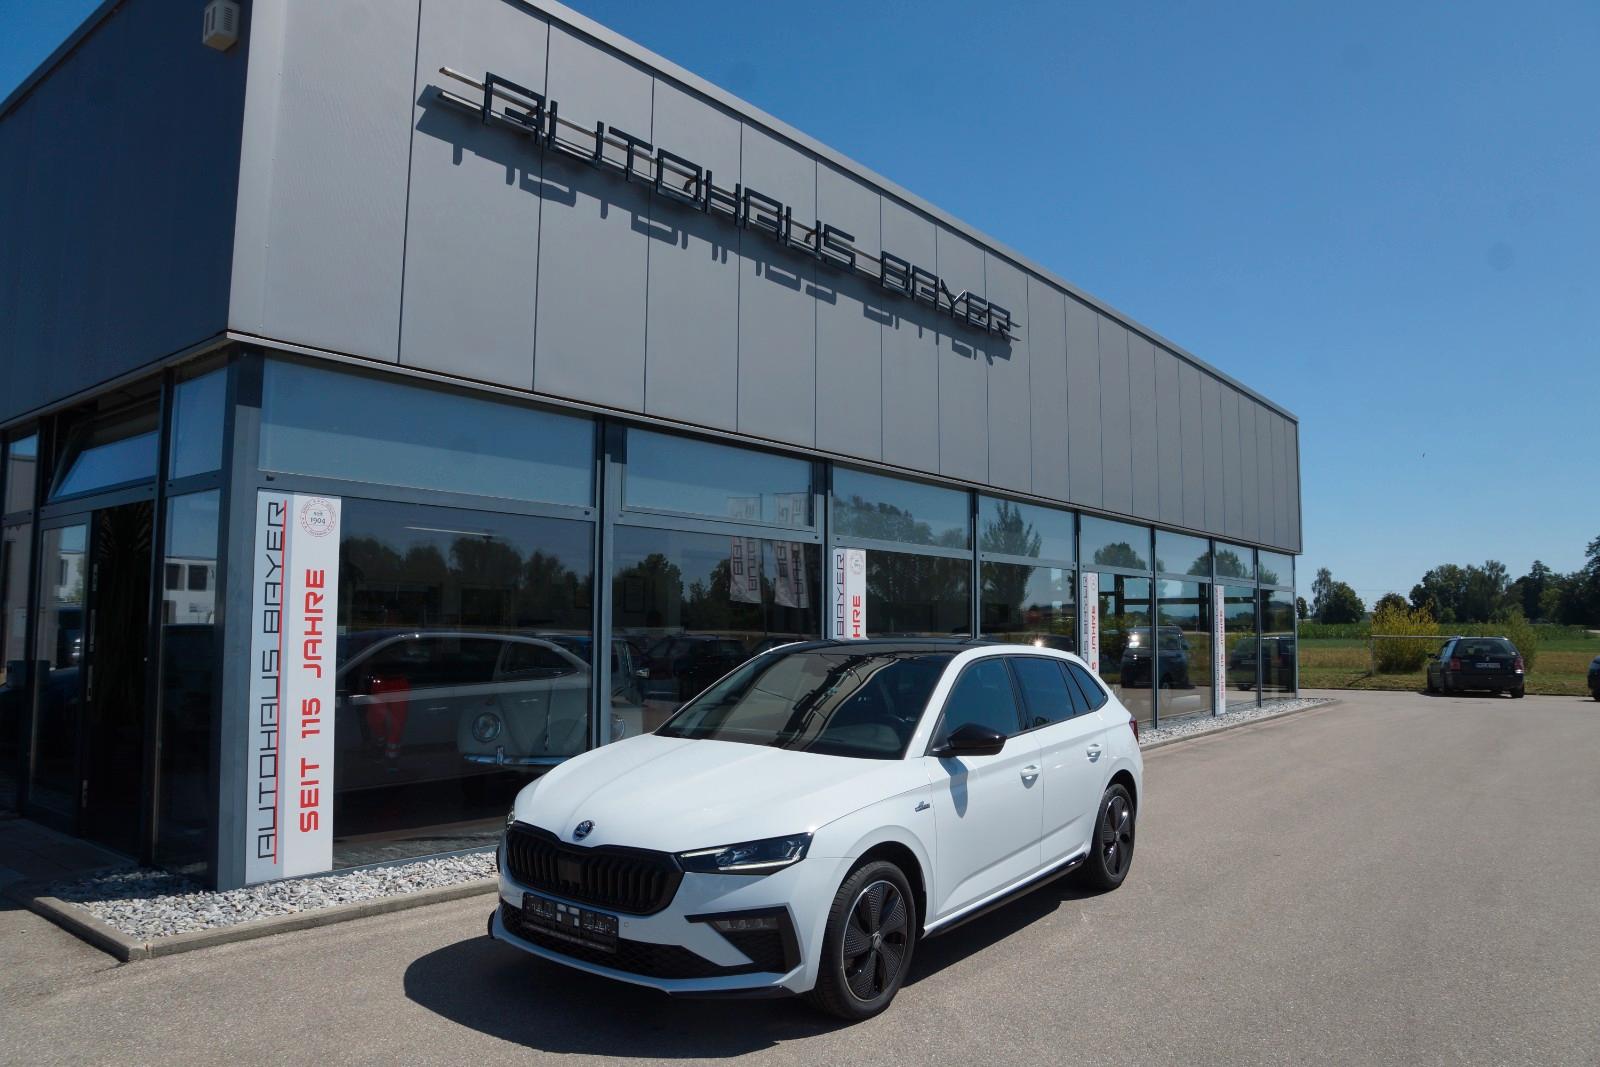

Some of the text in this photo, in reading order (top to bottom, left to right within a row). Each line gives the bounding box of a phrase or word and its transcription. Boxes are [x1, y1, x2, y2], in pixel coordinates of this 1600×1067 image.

[482, 71, 1011, 339] AUTOHAUS BAYER
[257, 501, 285, 859] AUTOHAUS BAYER
[300, 568, 325, 833] SEIT 115 JAHRE
[836, 553, 845, 636] BAYER
[852, 595, 861, 638] HRE
